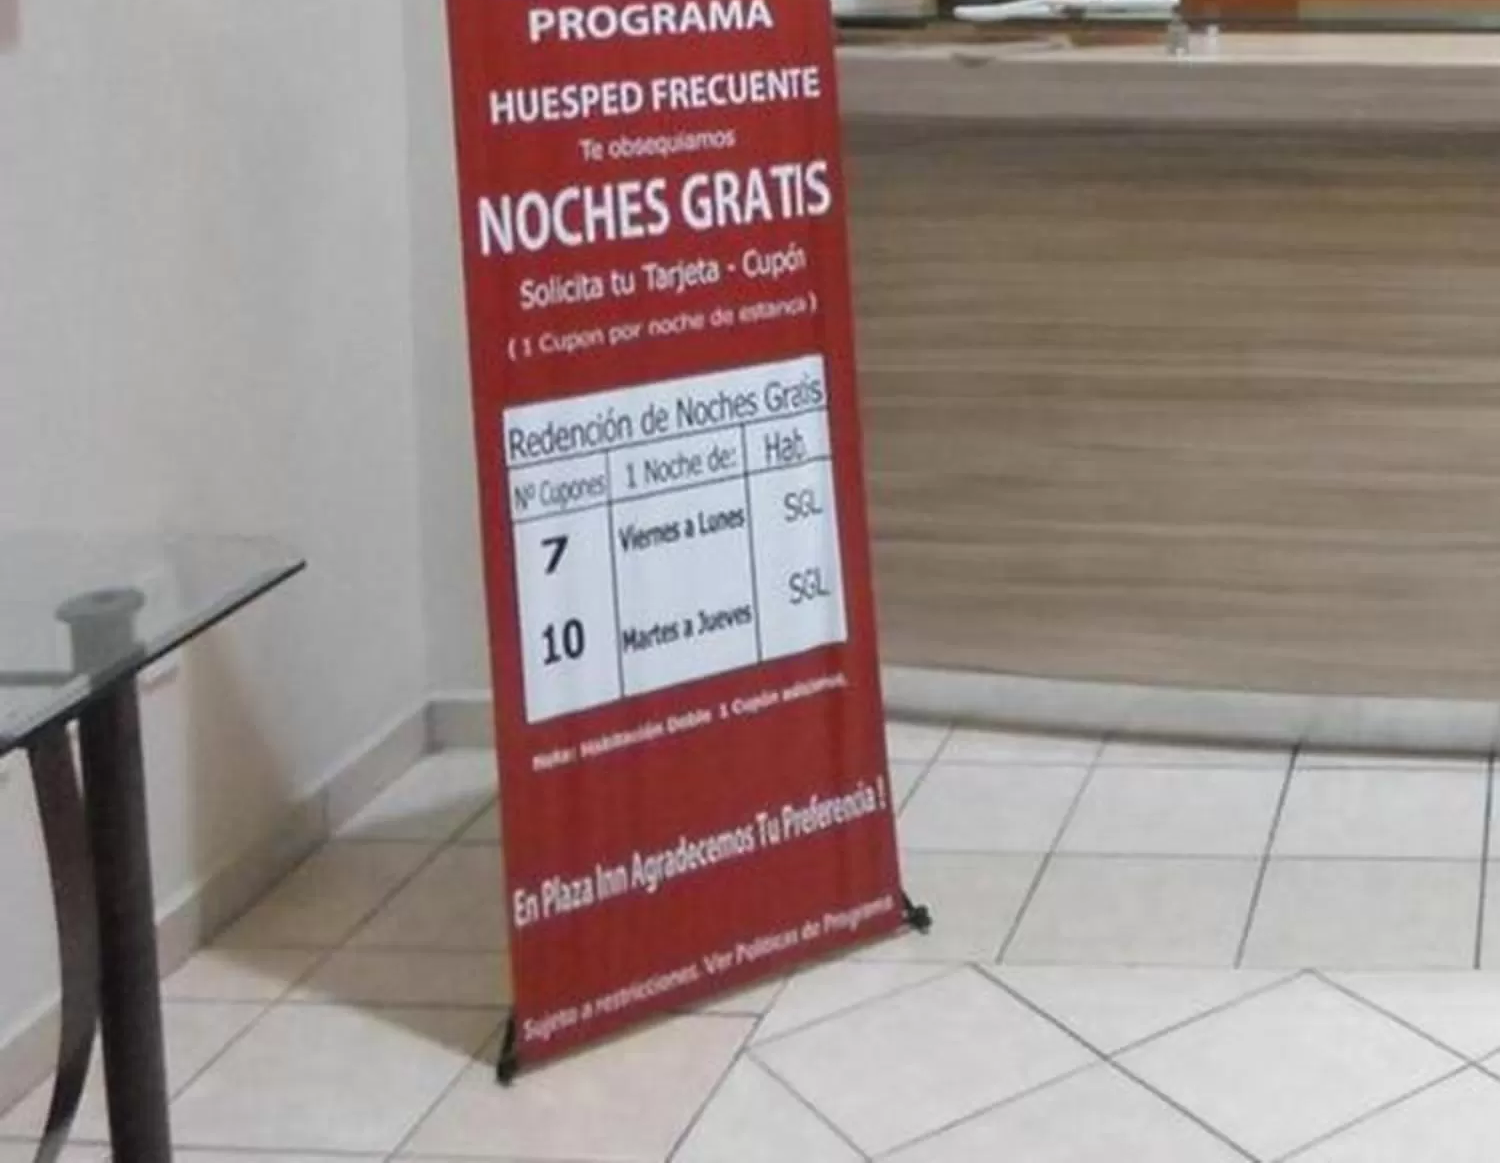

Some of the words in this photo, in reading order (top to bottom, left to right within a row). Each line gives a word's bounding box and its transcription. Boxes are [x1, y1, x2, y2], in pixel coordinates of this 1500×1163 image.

[488, 80, 644, 125] HUESPED
[651, 65, 822, 112] FRECUENTE
[579, 137, 604, 162] Te
[607, 128, 736, 159] obsequiamos
[477, 177, 671, 256] NOCHES
[681, 159, 833, 229] GRATIS
[519, 276, 605, 311] Solicita
[610, 271, 635, 297] tu
[642, 258, 720, 294] Tarjeta
[608, 319, 643, 346] por
[648, 310, 705, 337] noche
[709, 306, 735, 327] de
[509, 406, 633, 461] Redención
[639, 401, 670, 435] de
[676, 387, 758, 430] Noches
[538, 473, 608, 509] Cupones
[625, 463, 638, 490] 1
[643, 452, 702, 488] Noche
[782, 488, 824, 523] SGL
[618, 516, 681, 553] Viernes
[683, 519, 696, 539] a
[698, 506, 745, 537] Lunes
[541, 534, 570, 576] 7
[788, 567, 831, 604] SGL
[541, 617, 586, 666] 10
[622, 620, 679, 654] Martes
[682, 620, 694, 639] a
[697, 602, 754, 638] Jueves
[512, 887, 540, 929] En
[540, 873, 595, 919] Plaza
[595, 861, 629, 902] Inn
[630, 822, 756, 895] Agradecemos
[755, 810, 782, 850] Tu
[781, 779, 876, 842] Preferencia
